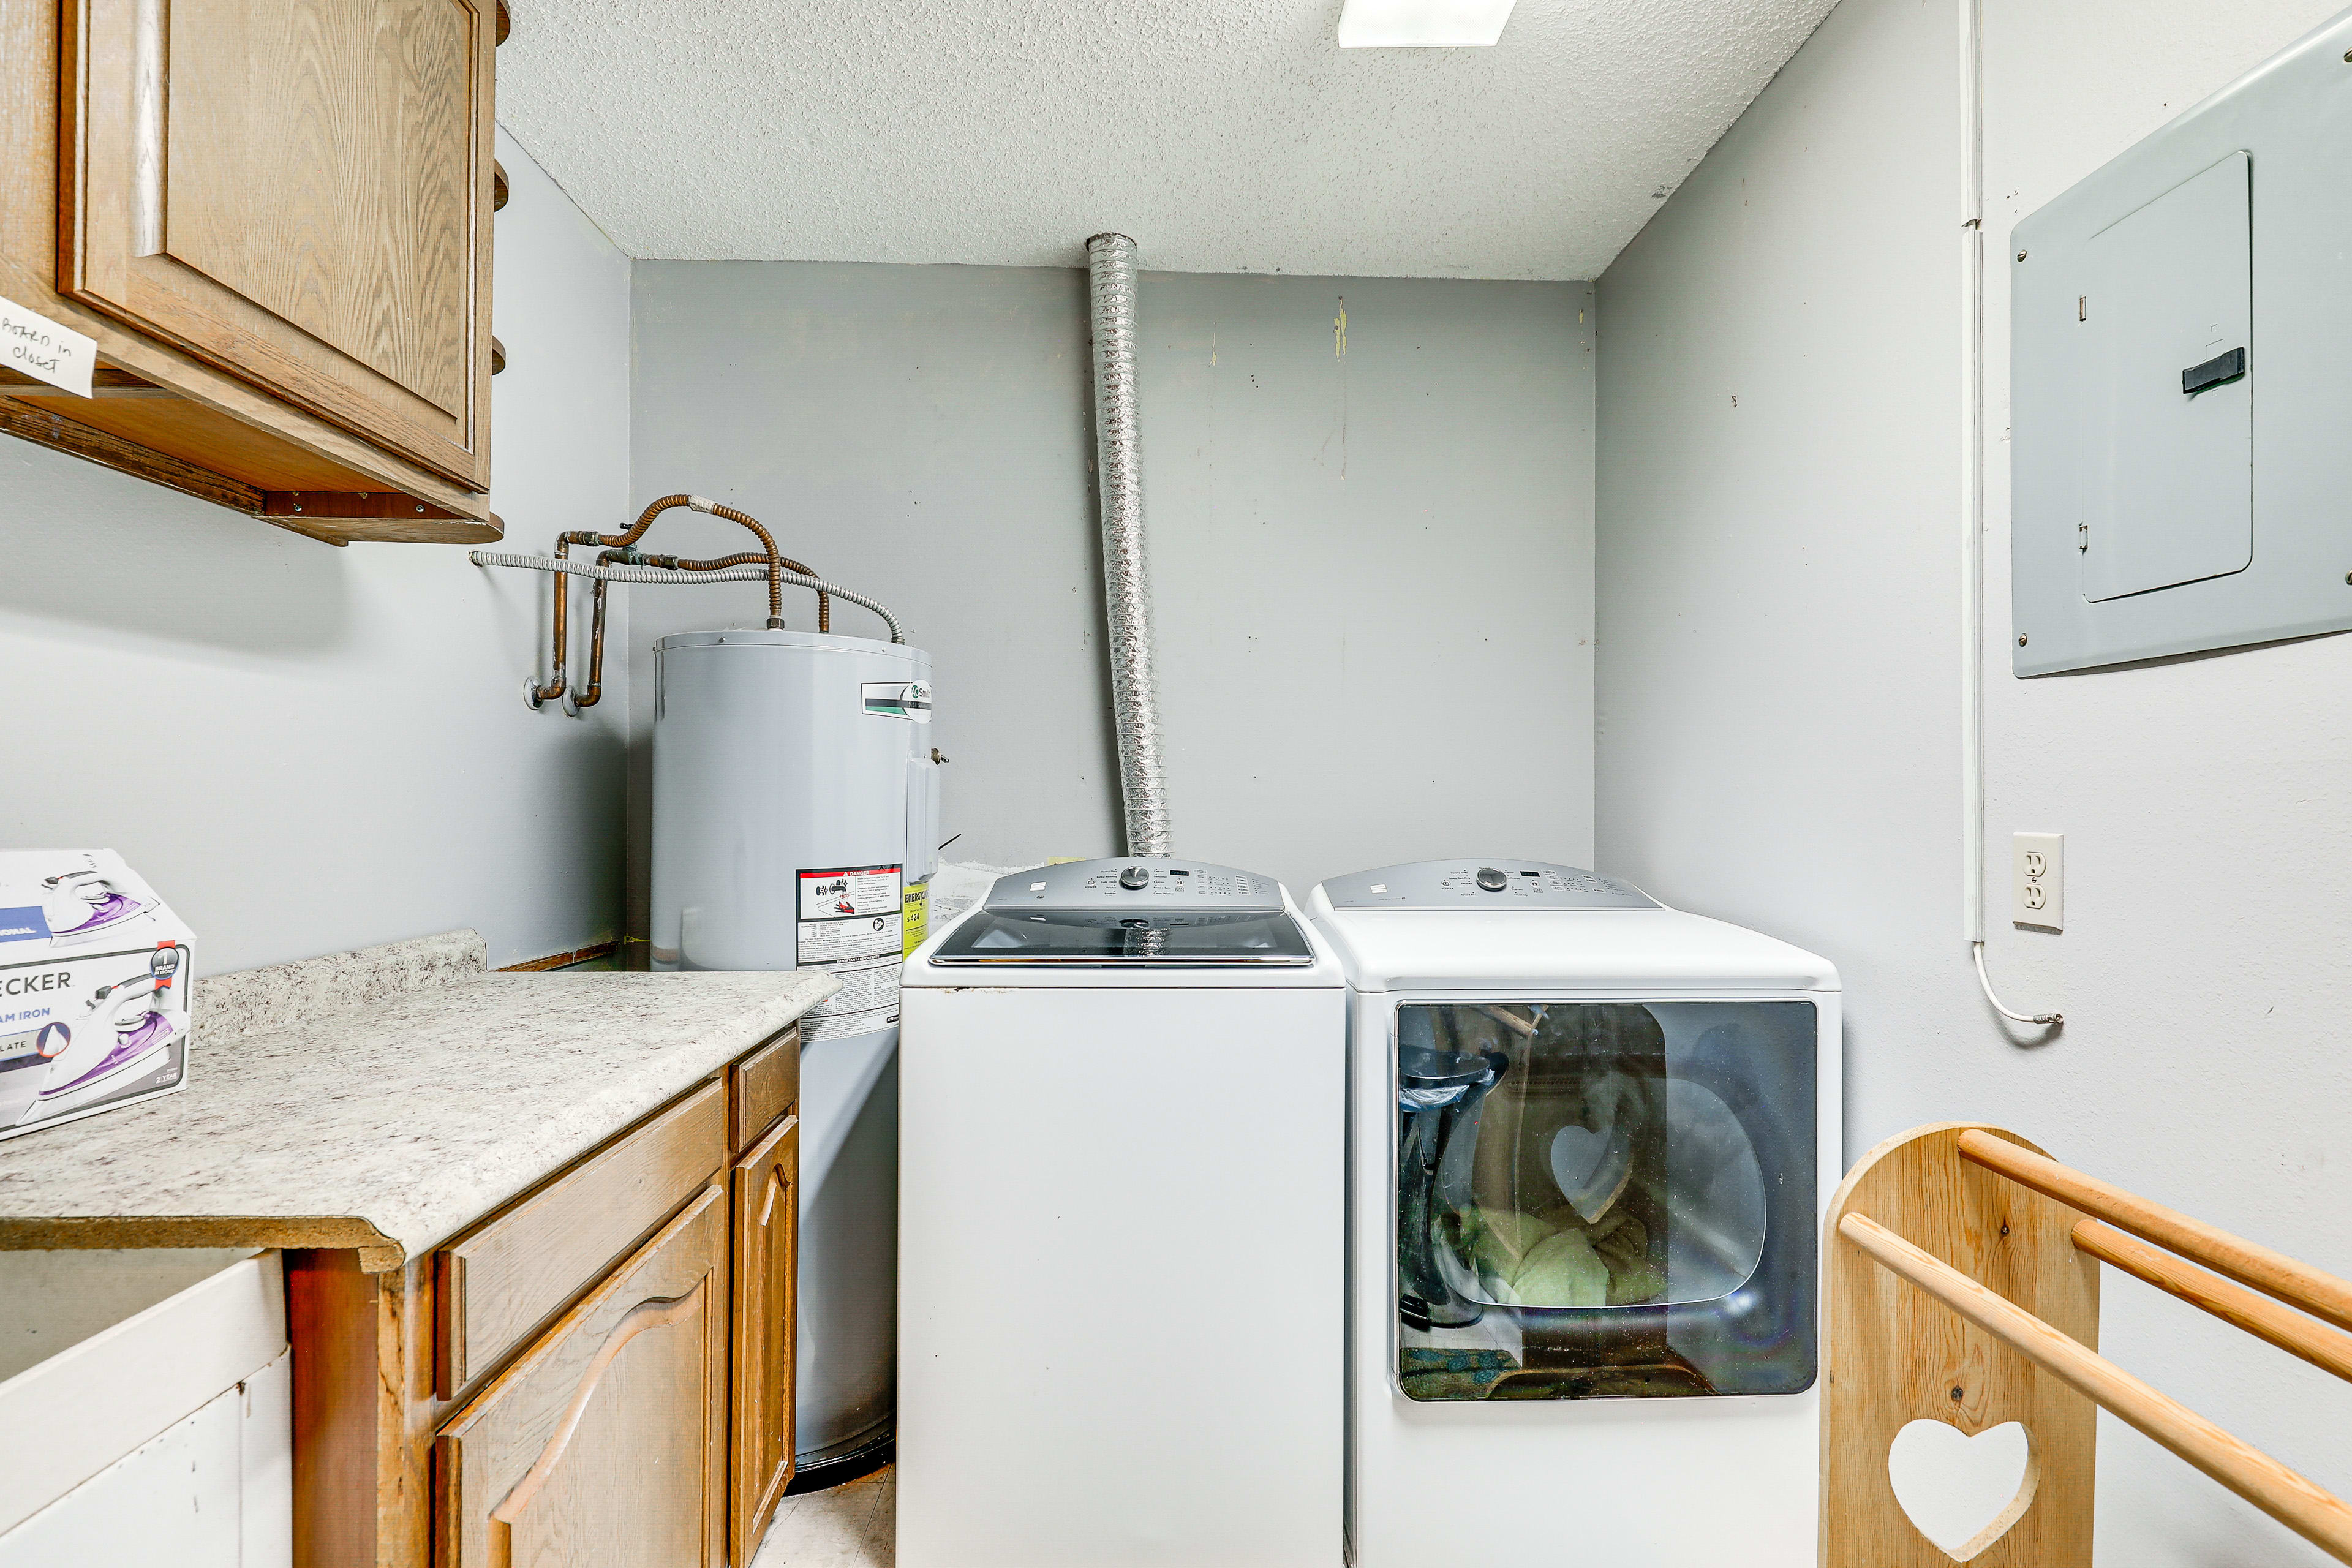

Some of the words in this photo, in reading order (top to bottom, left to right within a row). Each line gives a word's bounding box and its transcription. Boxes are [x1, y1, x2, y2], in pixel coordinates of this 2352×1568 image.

[58, 341, 71, 356] in
[911, 913, 919, 922] 424
[0, 972, 70, 997] CKER
[19, 1008, 50, 1020] IRON
[162, 1072, 177, 1081] YEAR
